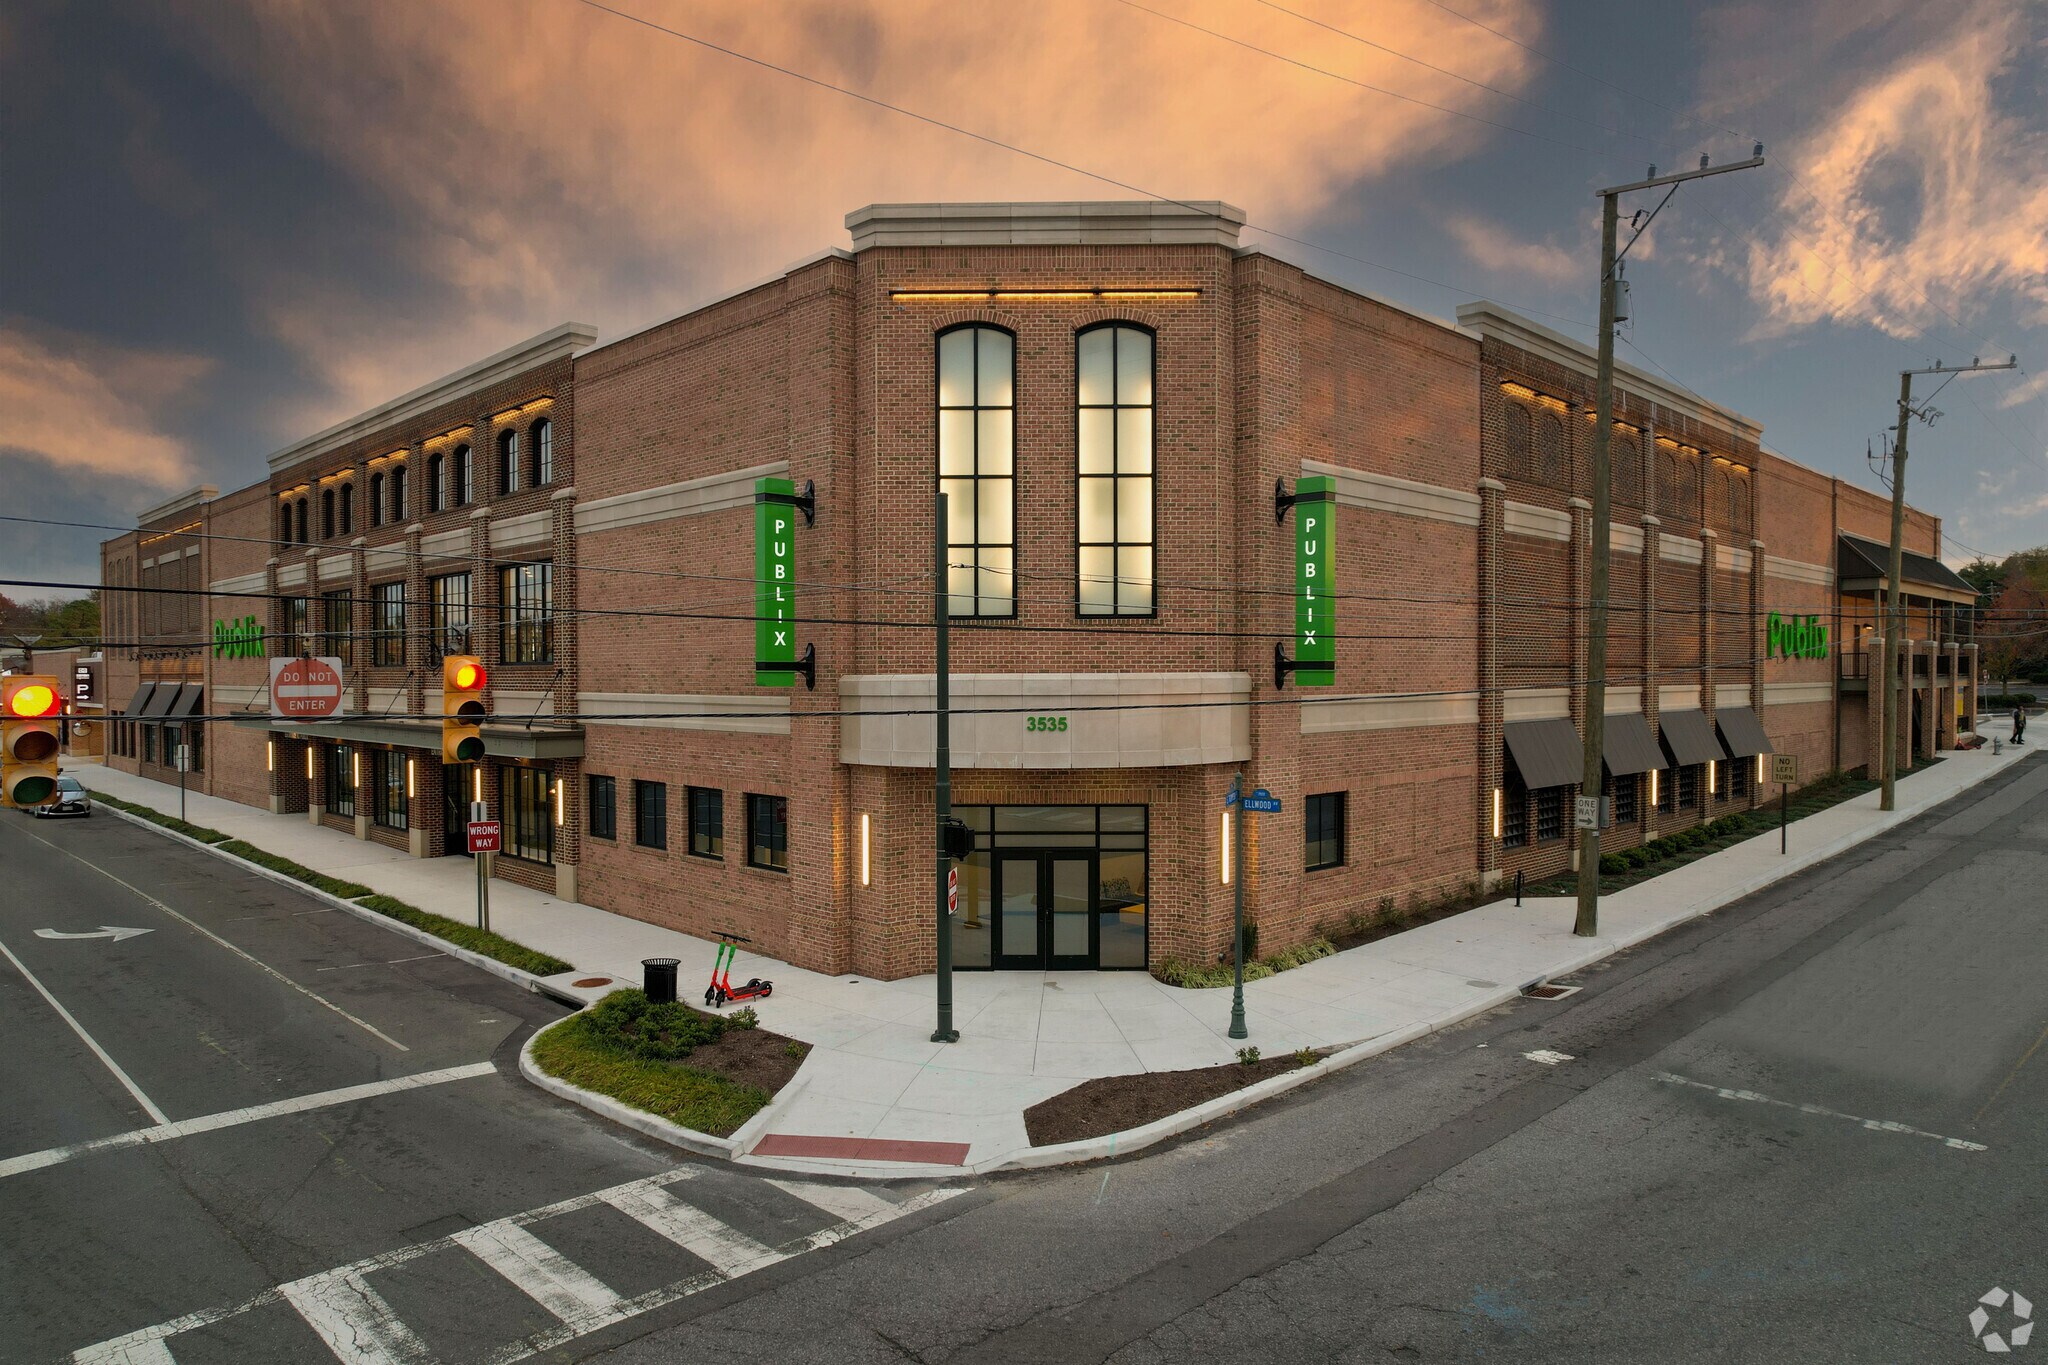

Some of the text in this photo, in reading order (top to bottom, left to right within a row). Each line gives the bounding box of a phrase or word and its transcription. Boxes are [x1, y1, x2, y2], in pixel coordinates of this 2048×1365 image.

[774, 519, 787, 646] PUBLIX
[1304, 518, 1317, 645] PUBLIX
[213, 614, 265, 658] Publix
[1767, 611, 1828, 658] Publix
[284, 672, 332, 682] DO NOT
[77, 684, 89, 694] P
[289, 700, 326, 711] ENTER
[1027, 716, 1068, 731] 3535
[1244, 800, 1272, 809] ELLWOOD
[1578, 800, 1596, 808] ONE
[470, 826, 498, 836] WRONG
[476, 838, 492, 848] WAY
